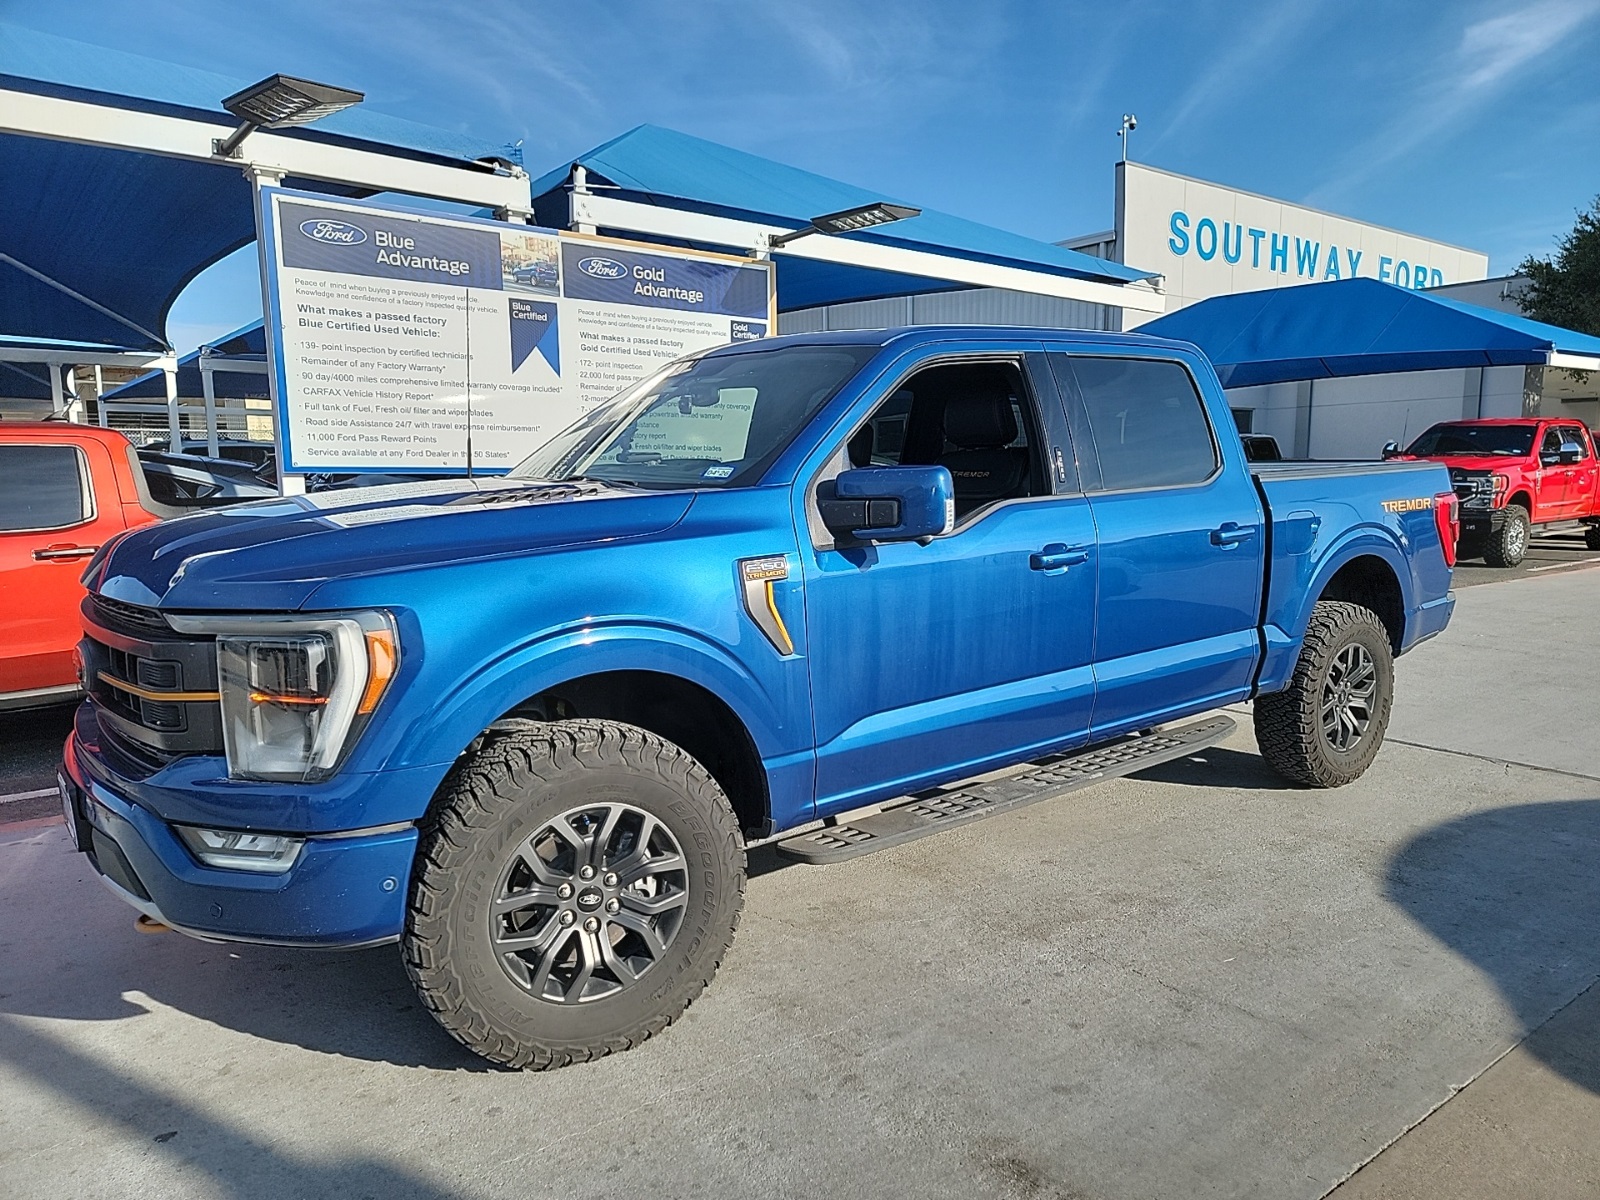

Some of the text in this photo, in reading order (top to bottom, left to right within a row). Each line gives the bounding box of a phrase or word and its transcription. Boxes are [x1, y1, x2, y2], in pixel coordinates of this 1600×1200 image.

[375, 231, 415, 250] Blue
[1169, 211, 1442, 290] SOUTHWAY FORD
[376, 251, 470, 275] Advantage
[633, 266, 665, 281] Gold
[295, 278, 317, 286] Peace
[330, 282, 346, 290] mind
[348, 284, 366, 292] when
[368, 285, 390, 295] buying
[398, 289, 430, 300] previously
[431, 293, 456, 303] enjoyed
[458, 295, 479, 303] vehcle.
[633, 284, 703, 302] Advantage
[296, 288, 334, 299] Knowledge
[336, 291, 349, 299] and
[351, 292, 386, 303] confidence
[402, 298, 423, 308] factory
[425, 300, 454, 310] inspected
[456, 304, 475, 313] quaity
[512, 303, 531, 312] Blue
[297, 304, 325, 314] What
[328, 307, 362, 318] makes
[375, 311, 410, 324] passed
[413, 314, 446, 327] factory
[512, 311, 547, 321] Certified
[299, 318, 440, 338] Blue Certified Used Vehicle:
[733, 331, 760, 339] Certified
[580, 332, 598, 341] What
[601, 334, 623, 343] makes
[633, 338, 656, 347] passed
[660, 339, 683, 349] factory
[300, 341, 319, 350] 139-
[322, 343, 342, 353] point
[344, 345, 385, 356] inspection
[400, 348, 429, 359] certified
[581, 344, 679, 359] Gold Certified Used Vehicle:
[301, 357, 347, 367] Remainder
[360, 361, 374, 369] any
[377, 361, 407, 372] Factory
[596, 362, 610, 370] point
[612, 362, 643, 370] inspection
[580, 371, 601, 379] 22,000
[316, 373, 354, 383] day/4000
[357, 375, 377, 383] miles
[380, 377, 438, 389] comprehensive
[441, 379, 464, 388] limited
[499, 383, 530, 393] coverage
[580, 382, 614, 390] Remainder
[303, 387, 341, 396] CARFAX
[344, 389, 373, 398] Vehicle
[375, 390, 403, 401] History
[305, 403, 320, 411] Full
[322, 403, 340, 411] tank
[376, 406, 397, 414] Fresh
[414, 407, 430, 415] filter
[432, 407, 446, 415] and
[448, 409, 467, 417] wiper
[306, 418, 329, 426] Road
[350, 419, 392, 427] Assistance
[395, 420, 412, 428] 24/7
[432, 421, 452, 430] travel
[307, 434, 437, 443] 11,000 Ford Pass Reward Points
[308, 448, 339, 457] Service
[341, 449, 378, 457] available
[390, 451, 404, 459] any
[952, 470, 990, 478] TREMOR
[1381, 498, 1431, 512] TREMOR
[748, 571, 785, 579] TREMOR
[667, 800, 716, 974] BFGoodrich
